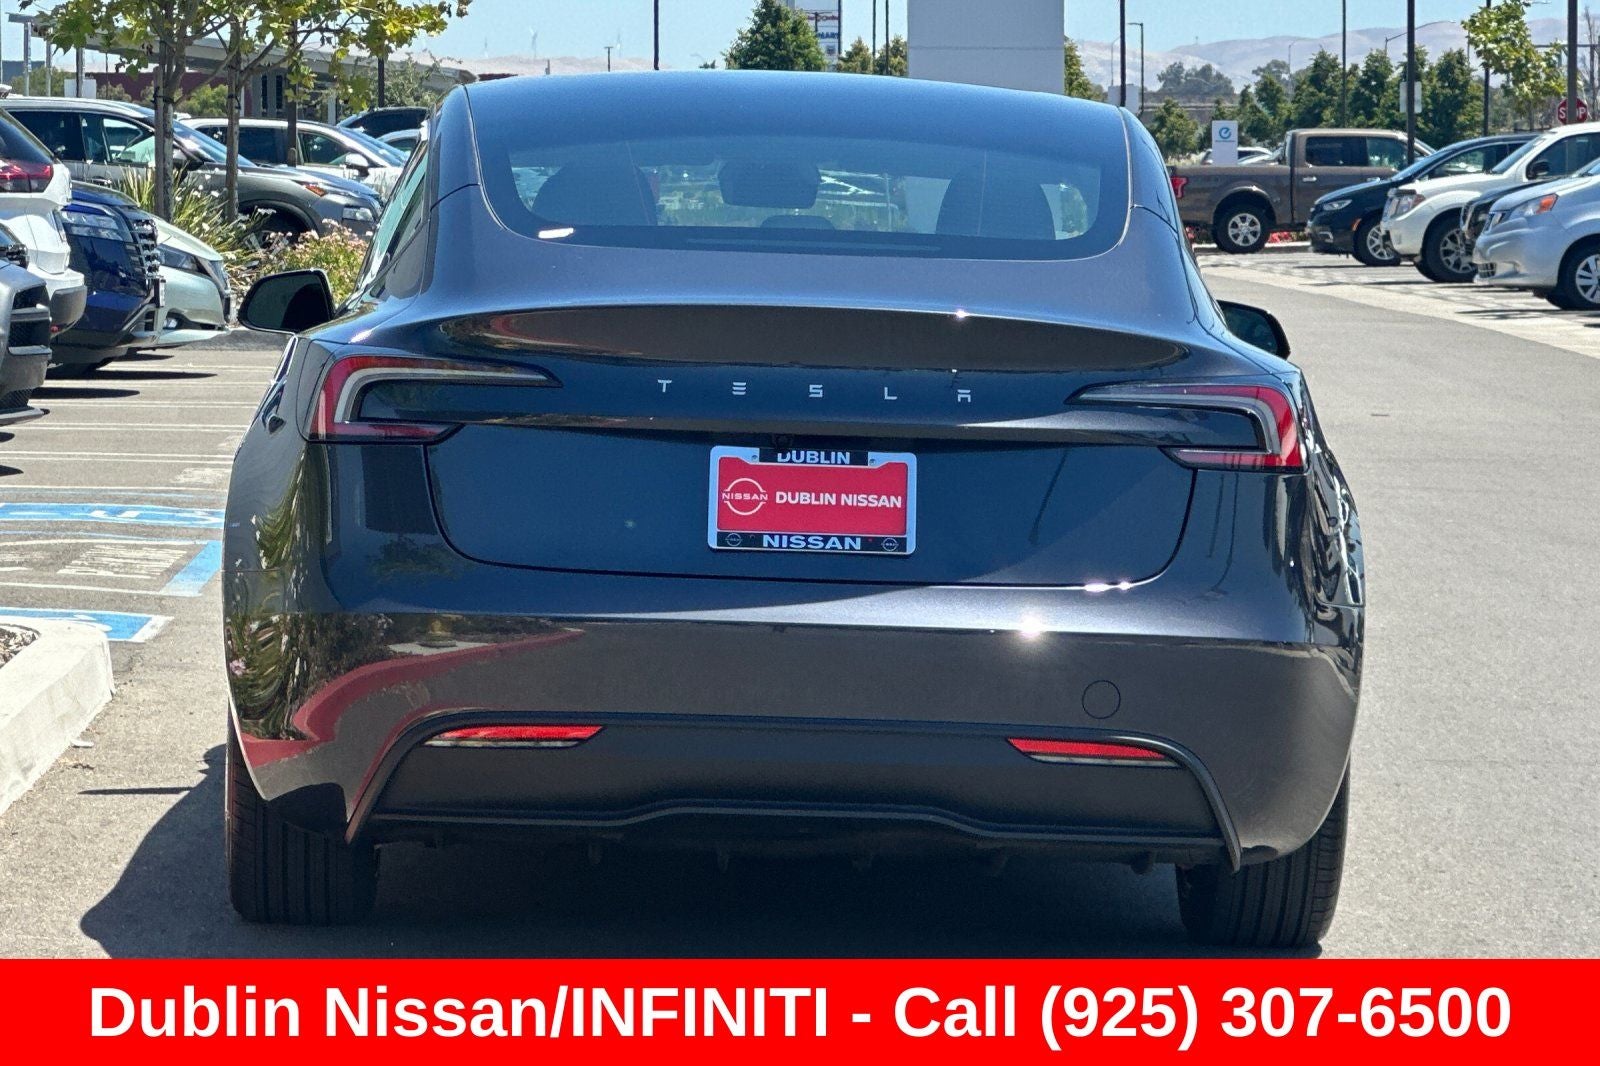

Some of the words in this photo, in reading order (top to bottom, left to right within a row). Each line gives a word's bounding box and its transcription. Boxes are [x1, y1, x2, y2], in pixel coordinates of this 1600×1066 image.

[1559, 107, 1586, 119] SP
[657, 379, 972, 403] TESLA
[776, 450, 850, 465] DUBLIN
[722, 492, 768, 501] NISSAN
[775, 491, 837, 506] DUBLIN
[840, 493, 902, 508] NISSAN
[762, 534, 861, 551] NISSAN
